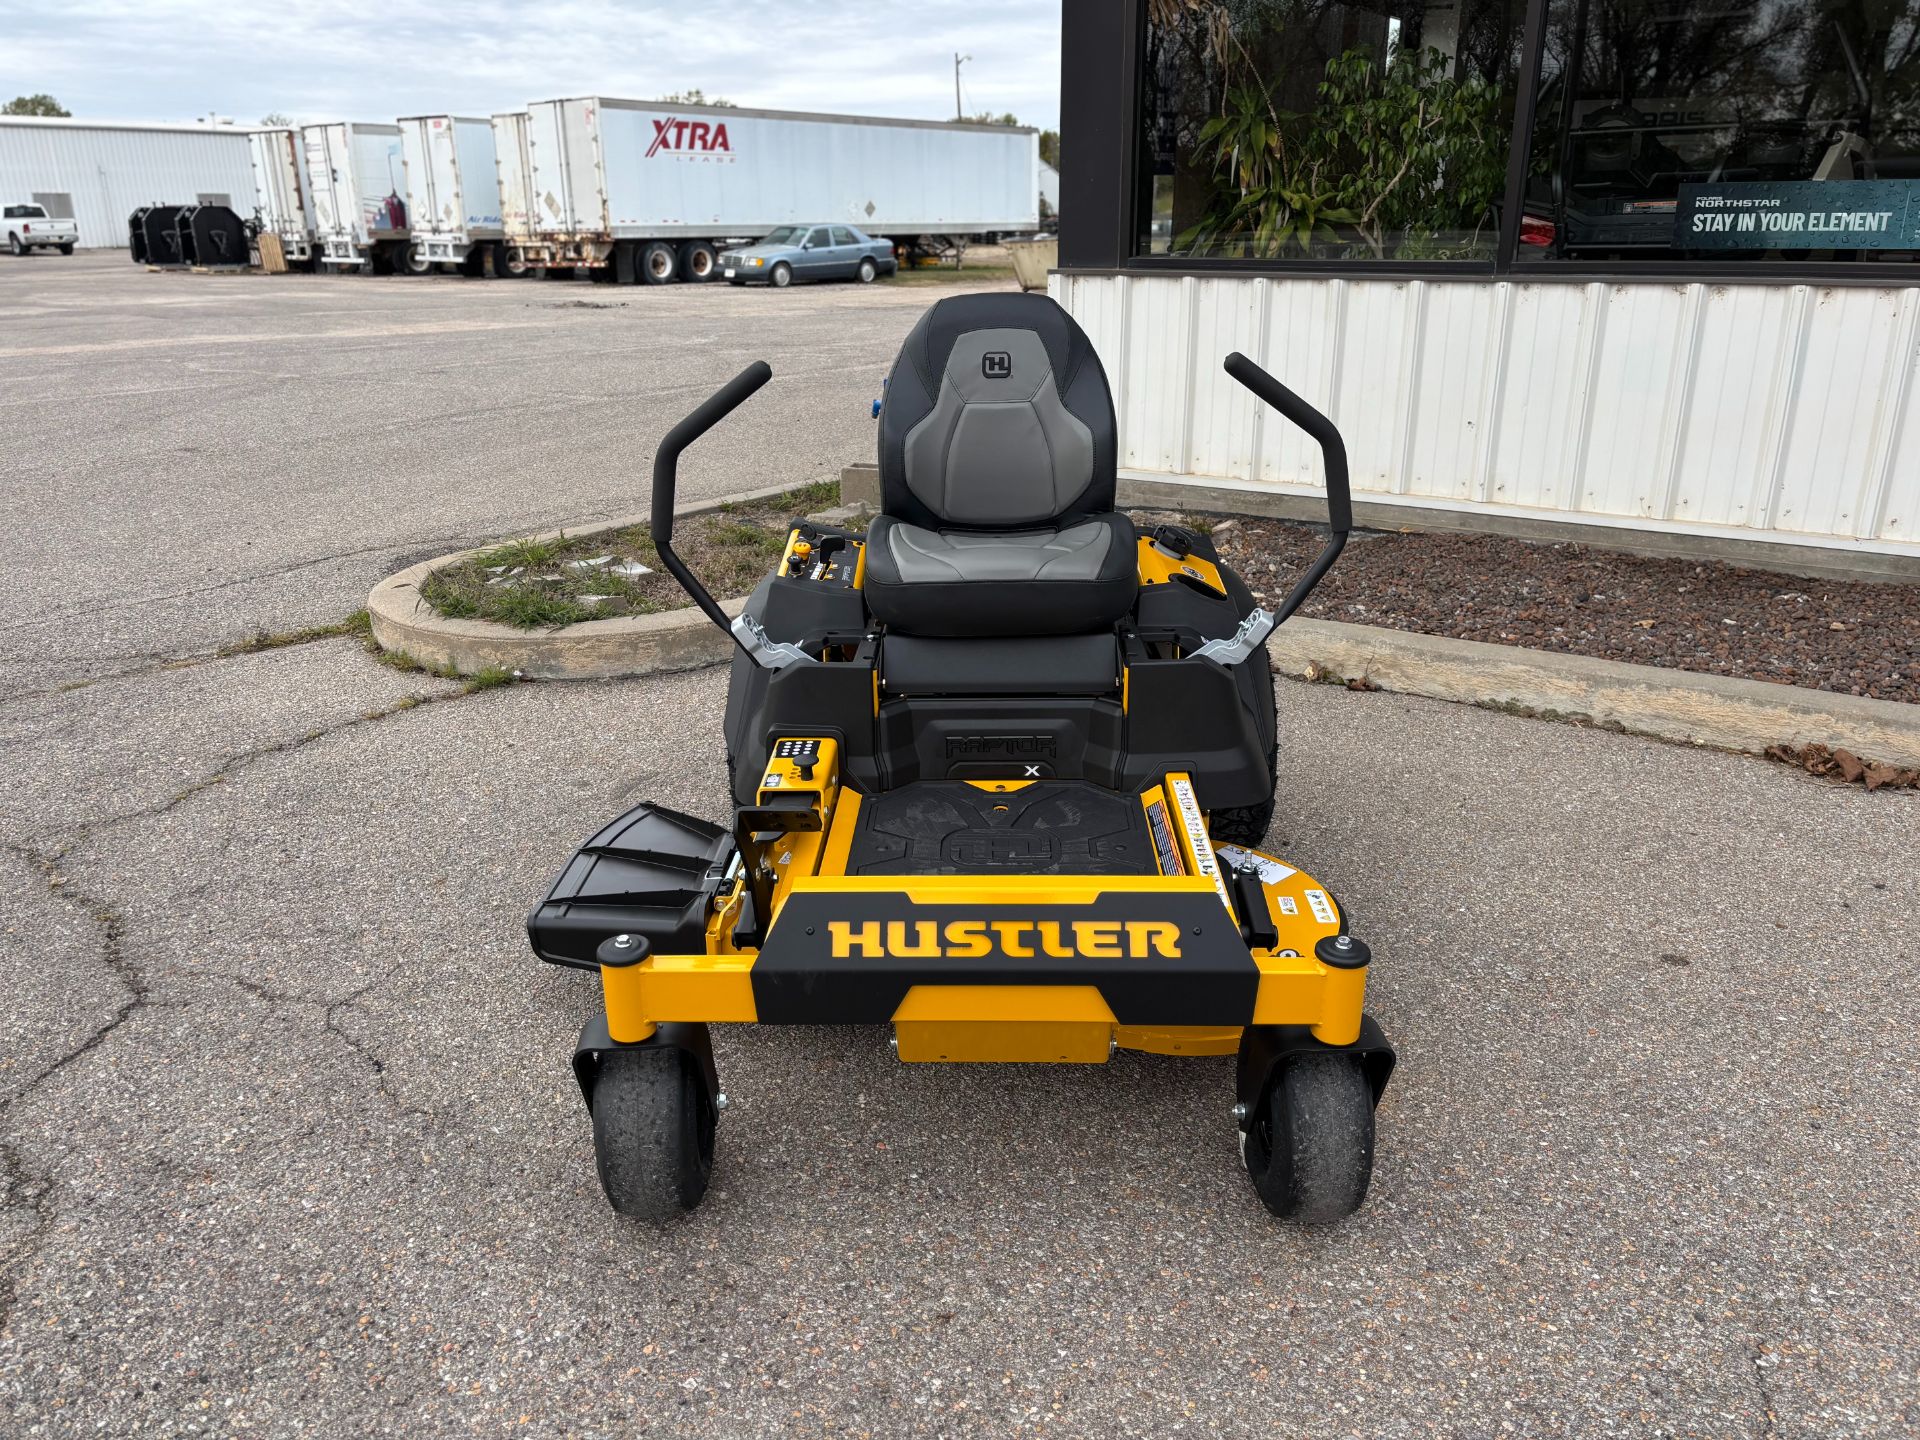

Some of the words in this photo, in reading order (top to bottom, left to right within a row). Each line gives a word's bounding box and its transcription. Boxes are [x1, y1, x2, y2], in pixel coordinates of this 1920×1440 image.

[645, 117, 730, 158] XTRA
[676, 156, 736, 164] LEASE
[1695, 199, 1780, 208] NORTHSTAR
[467, 215, 481, 224] Air
[1692, 213, 1735, 232] STAY
[1736, 213, 1756, 232] IN
[1760, 212, 1806, 232] YOUR
[1807, 211, 1893, 232] ELEMENT
[945, 735, 1057, 760] RAPTOR
[1024, 765, 1040, 776] X
[828, 920, 1182, 958] HUSTLER
